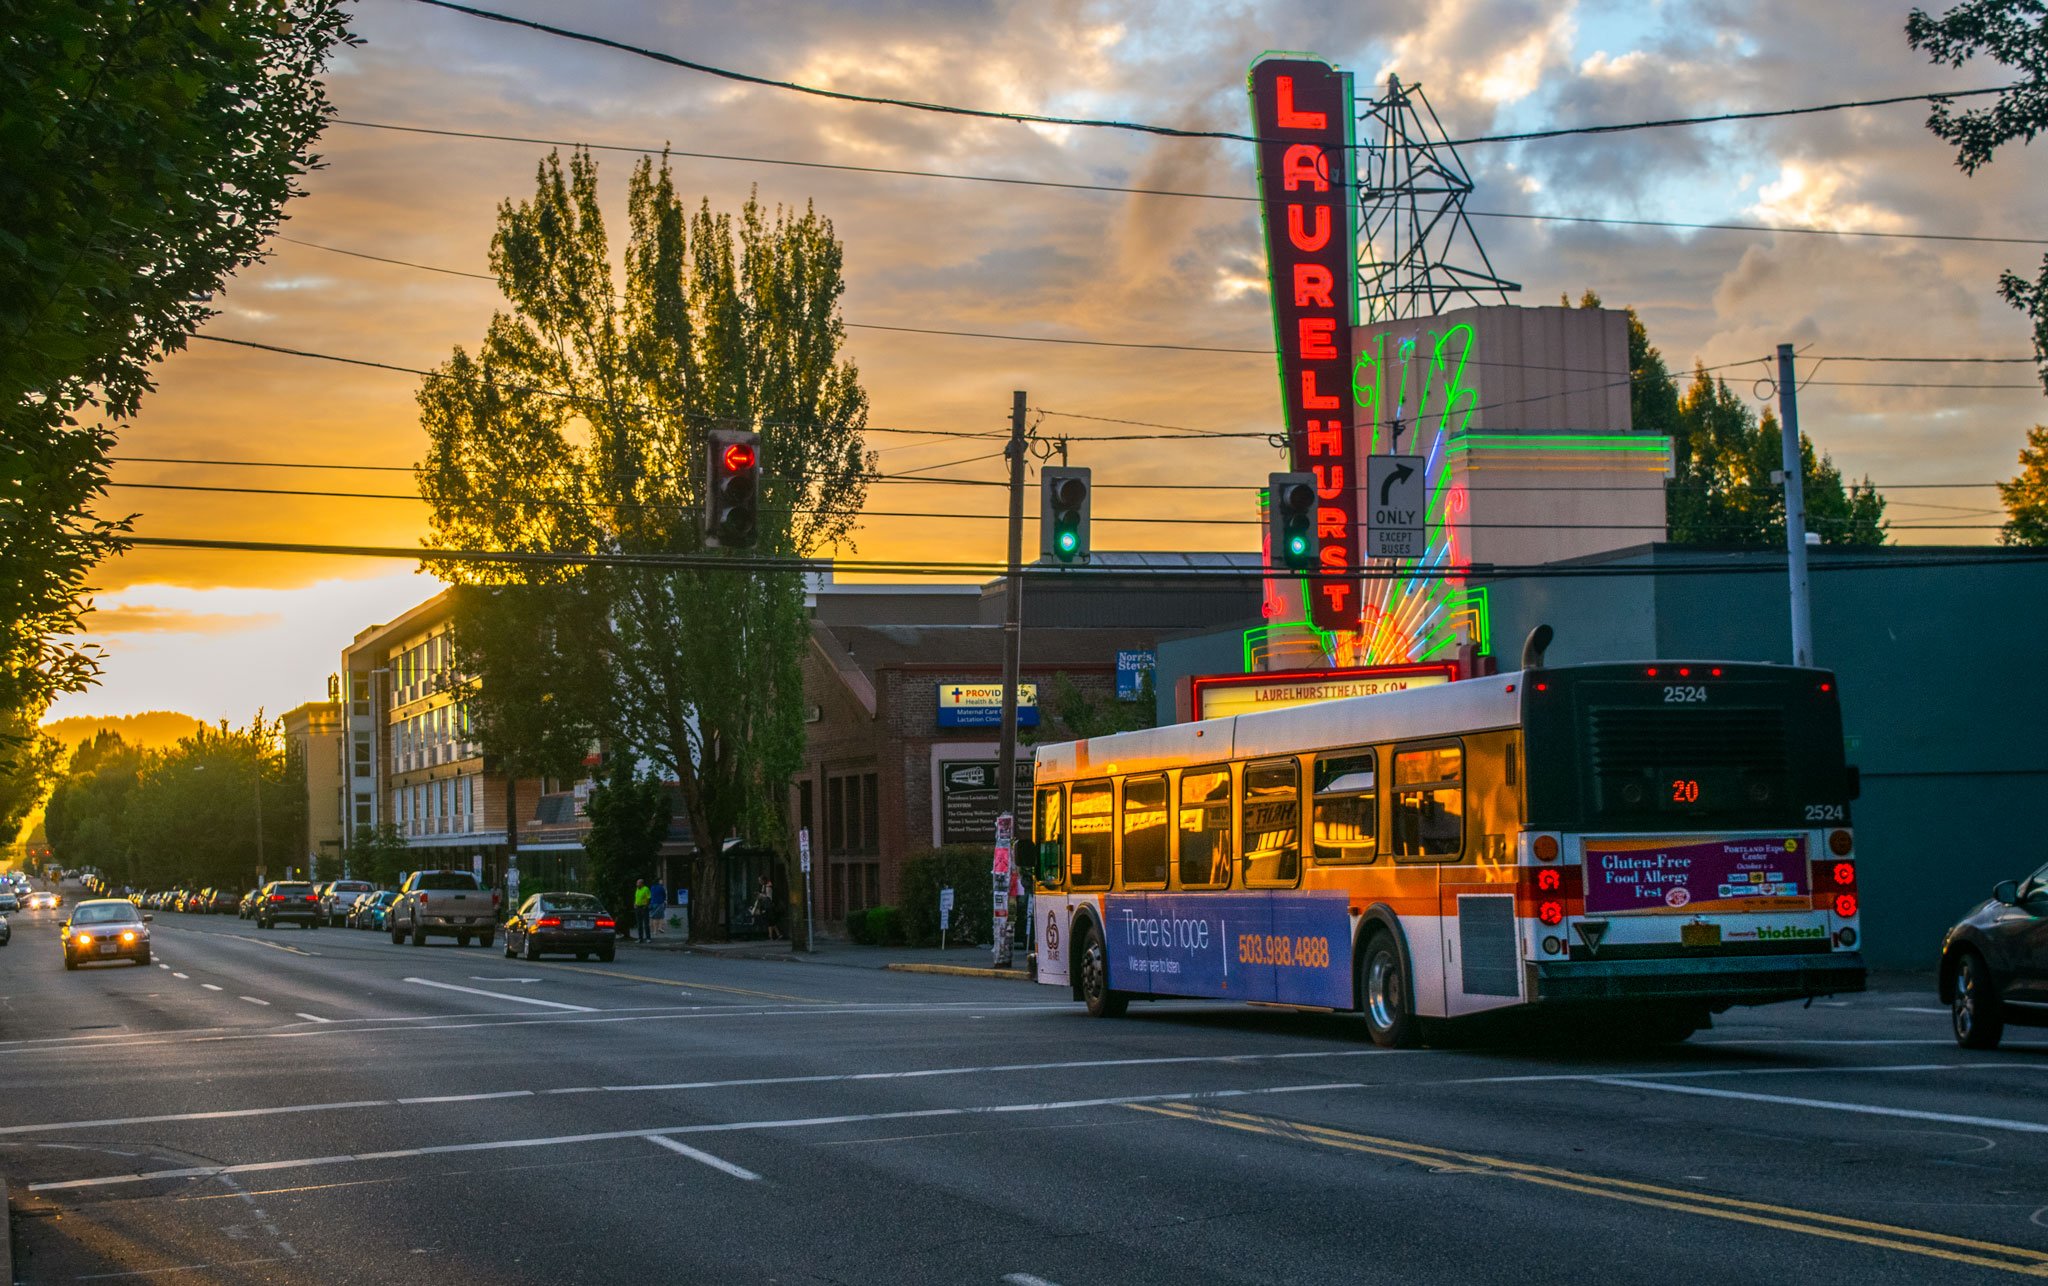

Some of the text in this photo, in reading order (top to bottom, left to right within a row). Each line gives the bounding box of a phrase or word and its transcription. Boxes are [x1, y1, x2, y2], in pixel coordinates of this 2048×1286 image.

[1275, 75, 1351, 612] LAURELHURST
[1376, 510, 1416, 525] ONLY
[1379, 532, 1412, 542] EXCEPT
[1381, 544, 1410, 554] BUSES
[1119, 651, 1152, 661] Norris
[965, 689, 1028, 697] PROVIDE
[1255, 682, 1408, 702] LAURELHURSTTHEATER.COM
[1664, 686, 1707, 702] 2524
[1672, 780, 1699, 802] 20
[1804, 805, 1844, 820] 2524
[1601, 854, 1691, 869] Gluten-Free
[1606, 870, 1689, 885] Food Allergy
[1635, 885, 1662, 897] Fest
[1122, 908, 1209, 957] There is hope
[1757, 925, 1825, 939] biodiesel
[1239, 934, 1329, 968] 503.988.4888
[1128, 955, 1138, 971] We
[1138, 959, 1147, 972] are
